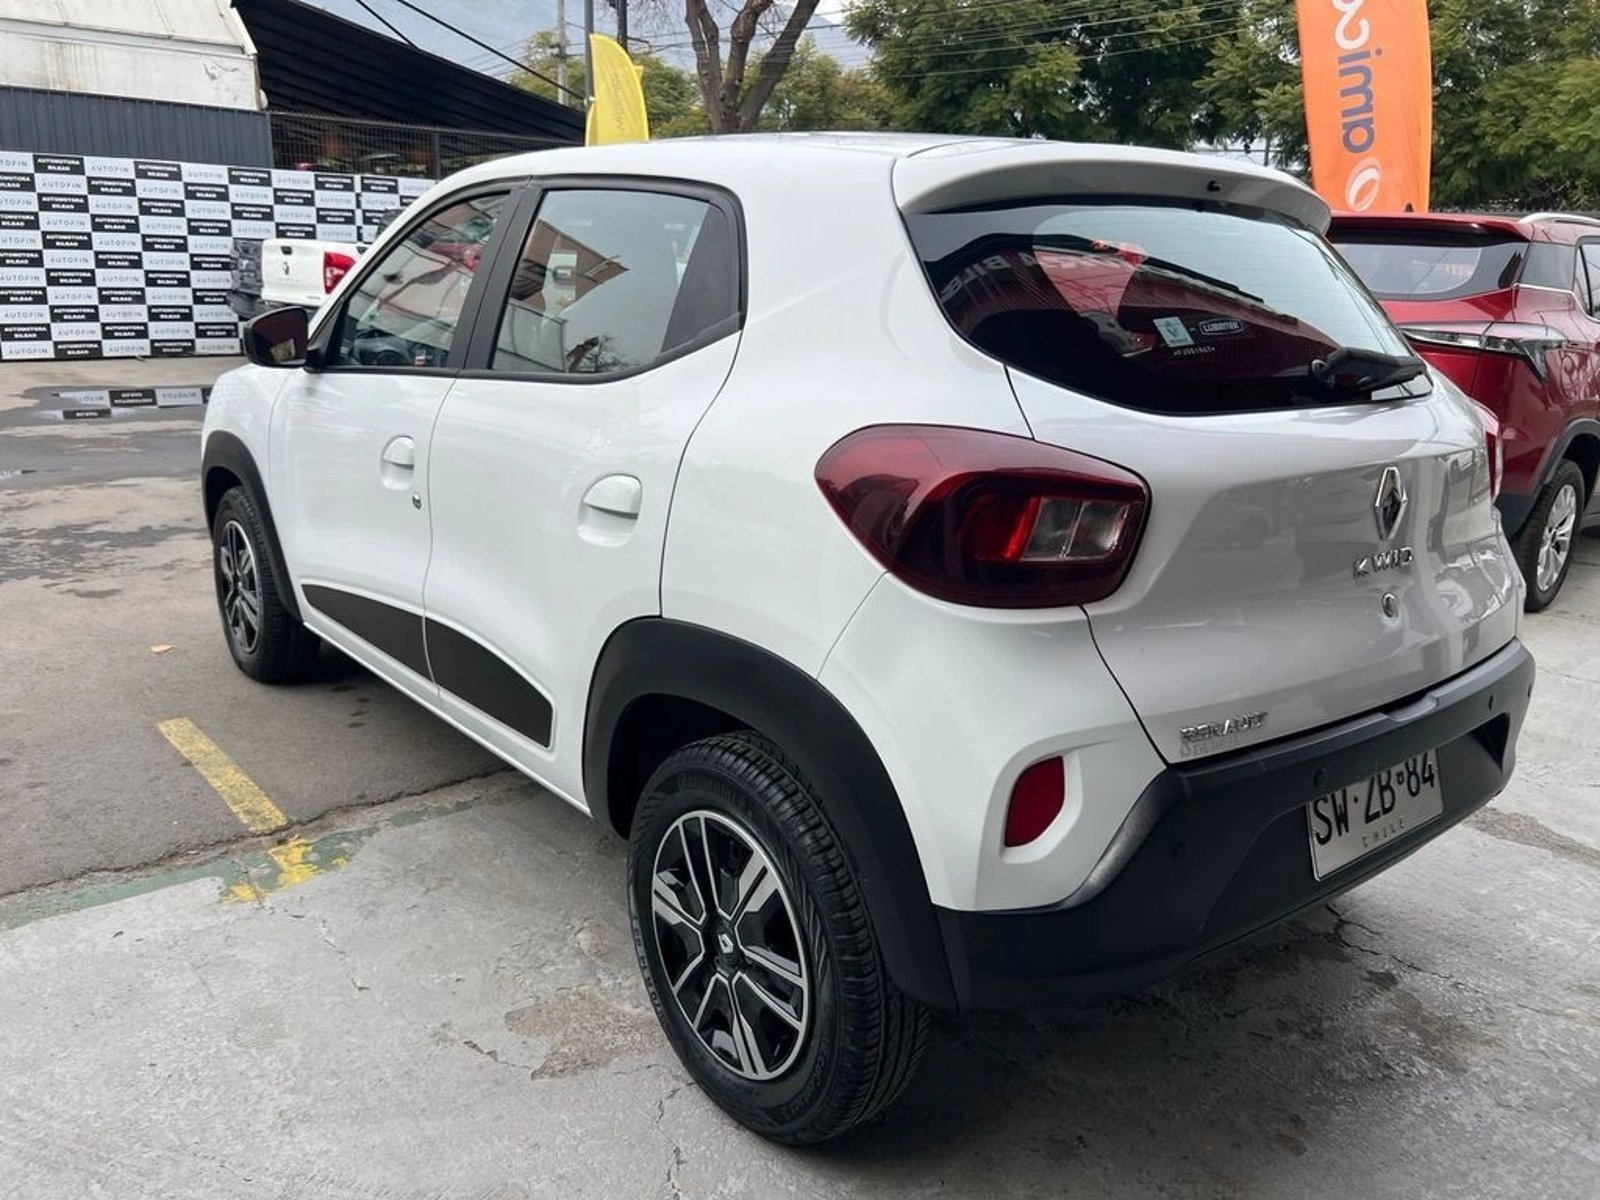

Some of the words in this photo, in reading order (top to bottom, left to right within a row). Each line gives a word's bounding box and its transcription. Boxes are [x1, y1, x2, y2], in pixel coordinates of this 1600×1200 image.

[90, 164, 129, 173] AUTOFIN
[41, 180, 81, 189] AUTOFIN
[142, 186, 179, 194] AUTOFIN
[94, 202, 133, 210] AUTOFIN
[45, 218, 85, 226] AUTOFIN
[145, 222, 182, 230] AUTOFIN
[1353, 546, 1414, 579] KWID
